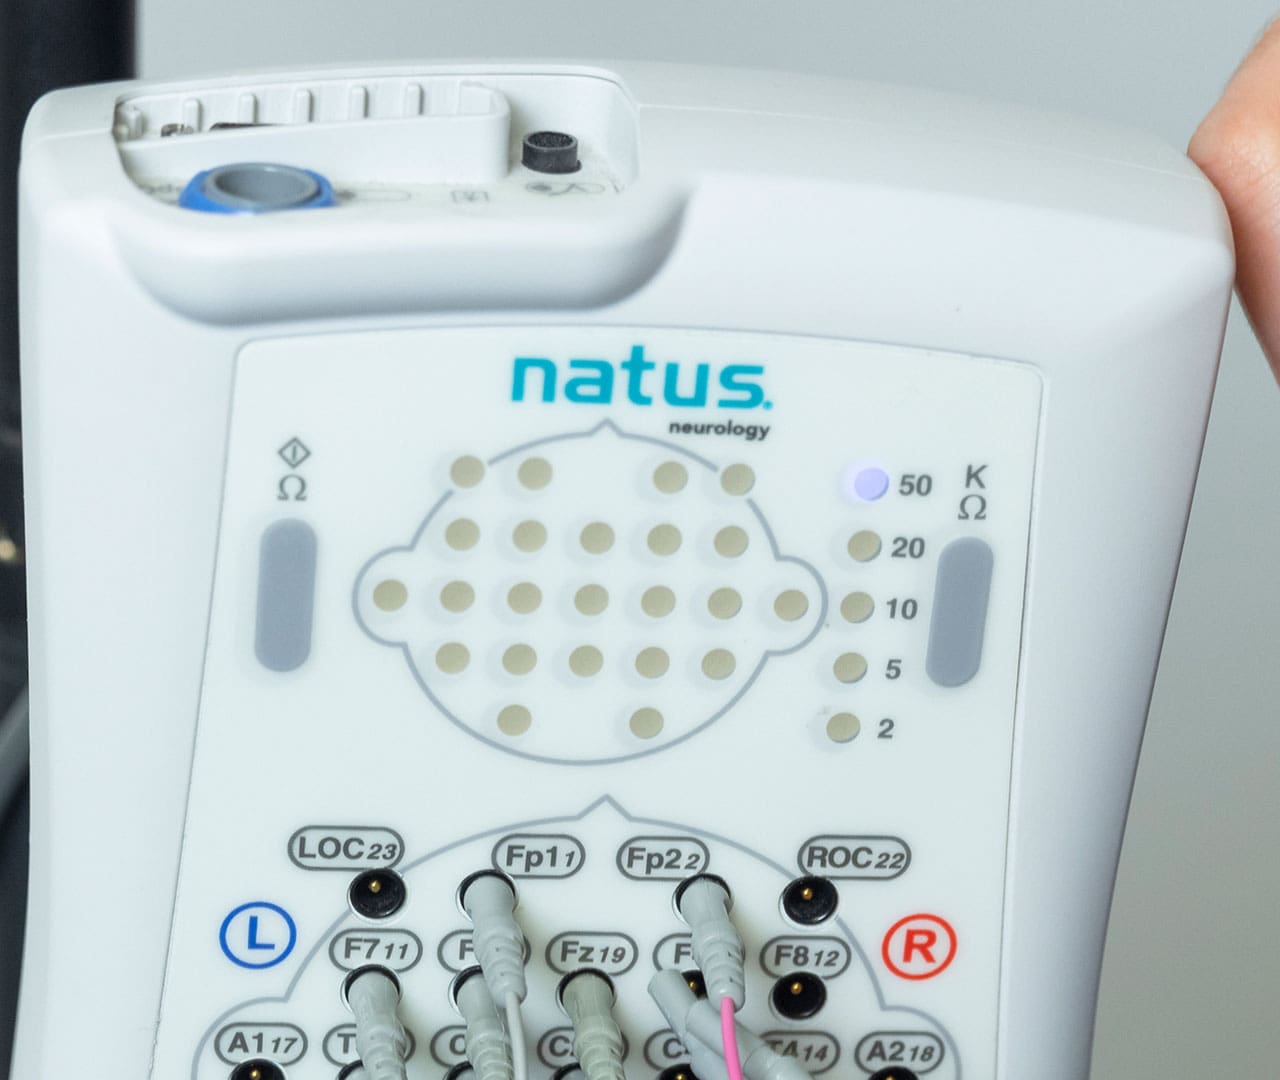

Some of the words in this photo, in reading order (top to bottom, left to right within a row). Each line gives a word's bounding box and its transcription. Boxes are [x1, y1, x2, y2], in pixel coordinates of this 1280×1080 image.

[669, 419, 771, 442] neurology
[898, 473, 934, 496] 50
[964, 464, 989, 490] K
[891, 536, 926, 559] 20
[885, 597, 918, 620] 10
[885, 659, 902, 680] 5
[877, 718, 895, 739] 2
[247, 915, 276, 951] L
[901, 929, 937, 964] R
